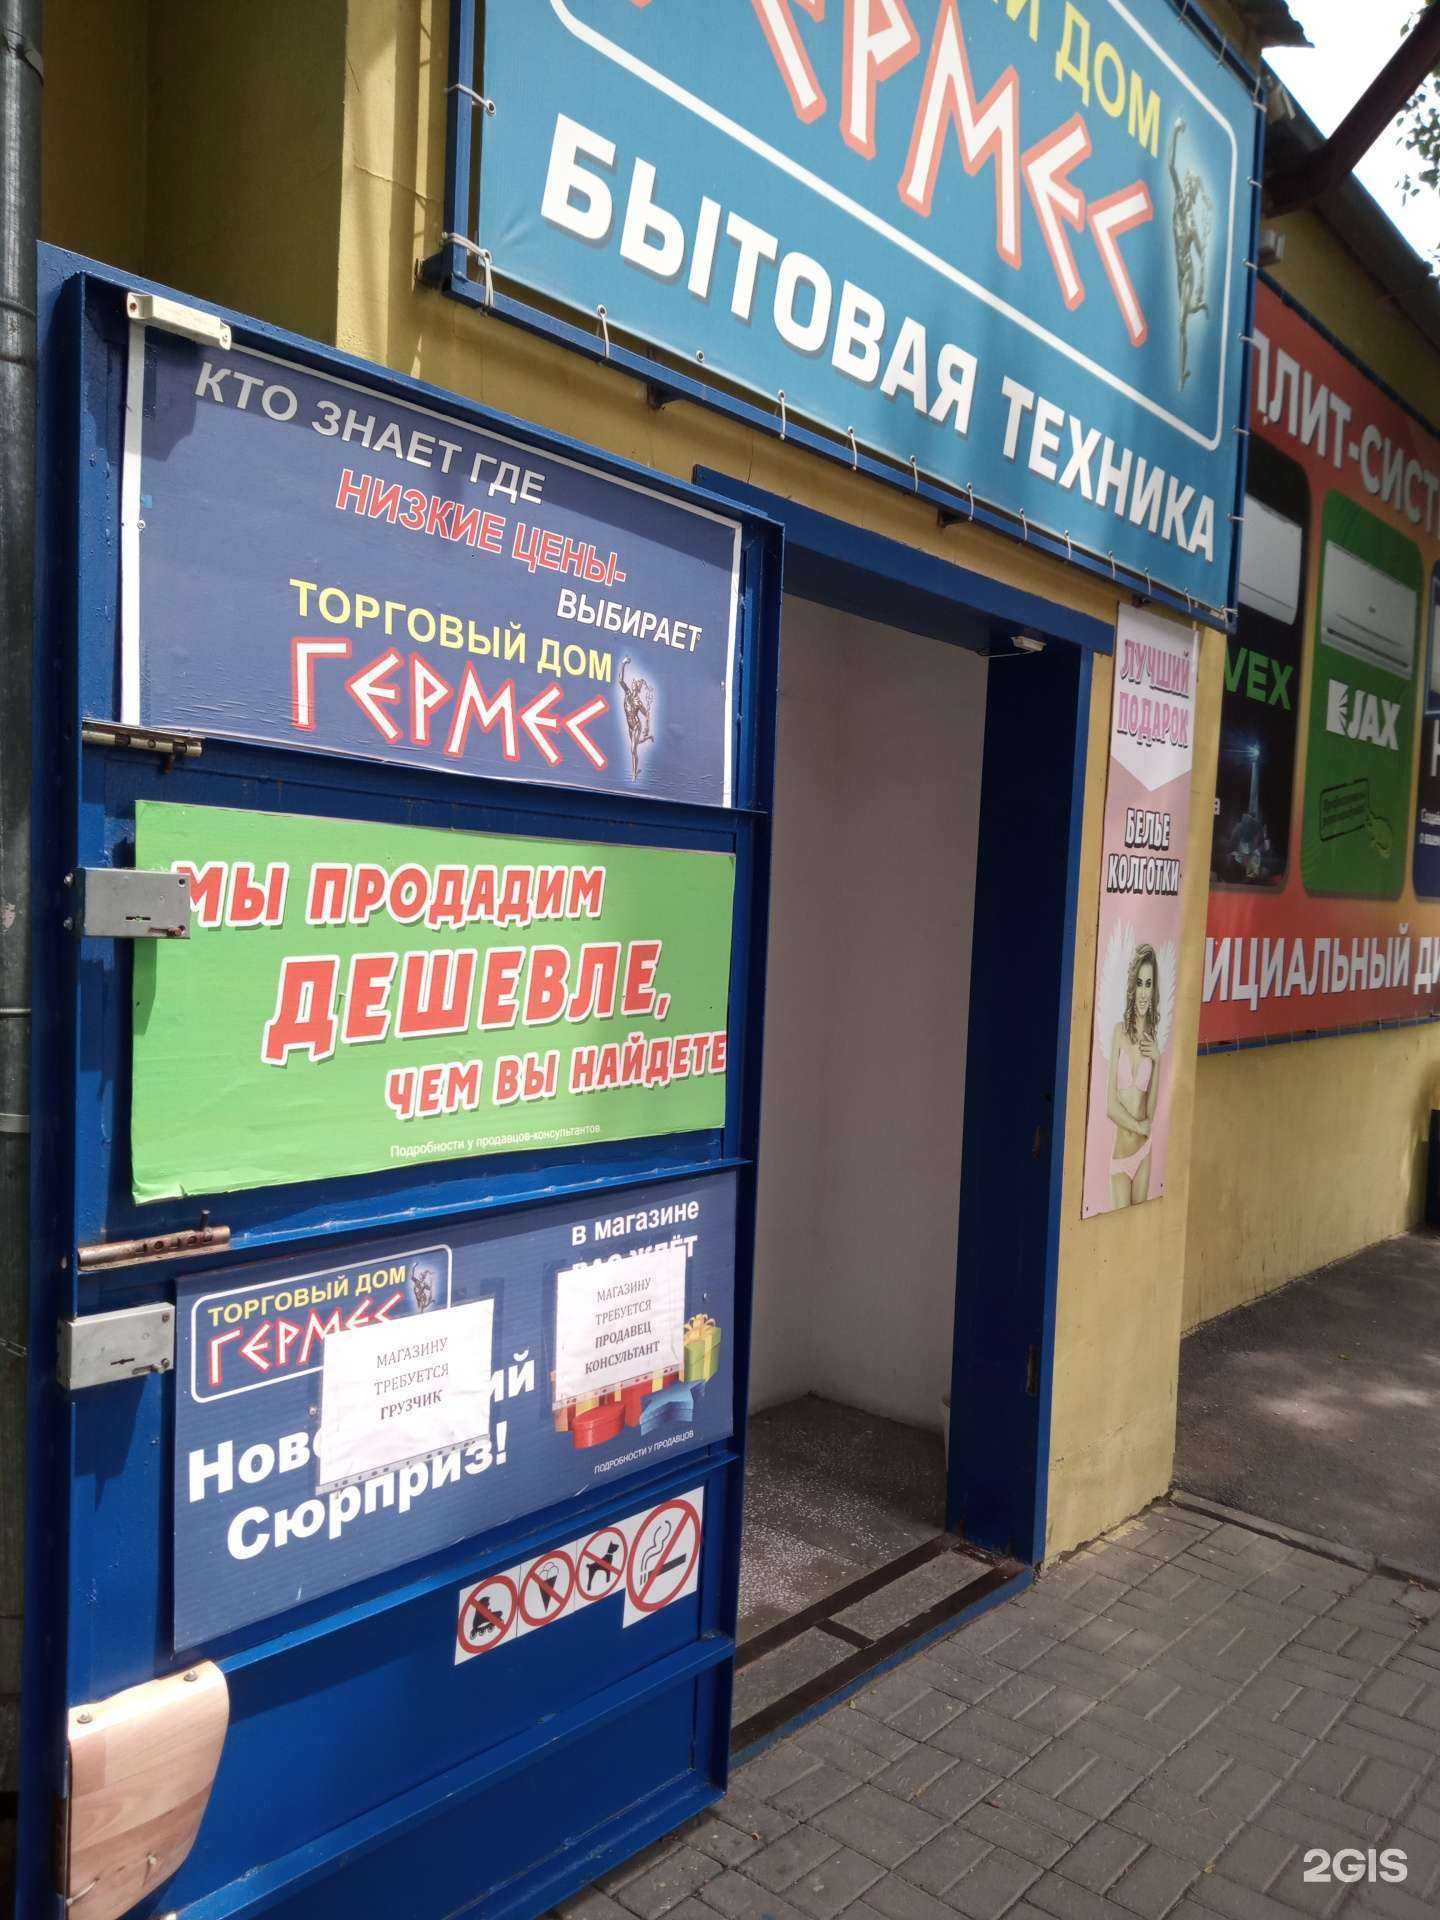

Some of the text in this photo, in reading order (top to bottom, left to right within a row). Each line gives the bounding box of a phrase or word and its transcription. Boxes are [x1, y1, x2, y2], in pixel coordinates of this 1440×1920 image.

[1055, 1, 1160, 158] ДОМ
[628, 0, 1153, 347] РМЕС
[540, 113, 1216, 563] БЫТОВАЯ ТЕХНИКА
[194, 361, 547, 505] КТО ЗНАЕТ ГДЕ
[335, 469, 628, 587] НИЗКИЕ ЦЕНЫ-
[289, 579, 613, 684] ТОРГОВЫЙ ДОМ
[557, 587, 703, 654] ВЫБИРАЕТ
[1121, 639, 1190, 699] ЛУЧШИЙ
[289, 635, 610, 771] ГЕРМЕС
[1117, 691, 1189, 749] ПОДАРОК
[1348, 689, 1400, 750] JAX
[1125, 807, 1170, 851] БЕЛЬЕ
[171, 861, 607, 930] МЫ ПРОДАДИМ
[1107, 853, 1180, 896] КОЛГОТКИ
[260, 939, 672, 1067] ДЕШЕВЛЕ,
[385, 1031, 728, 1120] ЧЕМ ВЫ НАЙДЕТЕ
[390, 1139, 465, 1159] Подробности
[476, 1124, 600, 1147] продавцов-консультантов
[594, 1200, 700, 1241] магазине
[208, 1265, 406, 1327] ТОРГОВЫЙ ДОМ
[595, 1299, 652, 1326] ТРЕБУЕТСЯ
[597, 1277, 652, 1303] МАГАЗИНУ
[376, 1336, 449, 1369] МАГАЗИНУ
[585, 1340, 661, 1374] КОНСУЛЬТАНТ
[595, 1321, 652, 1349] ПРОДАВЕЦ
[374, 1362, 449, 1396] ТРЕБУЕТСЯ
[379, 1389, 443, 1420] ГРУЗЧИК
[594, 1447, 647, 1474] ПОДРОБНОСТИ
[653, 1430, 694, 1451] ПРОДАВЦОВ
[227, 1420, 508, 1561] Сюрприз!
